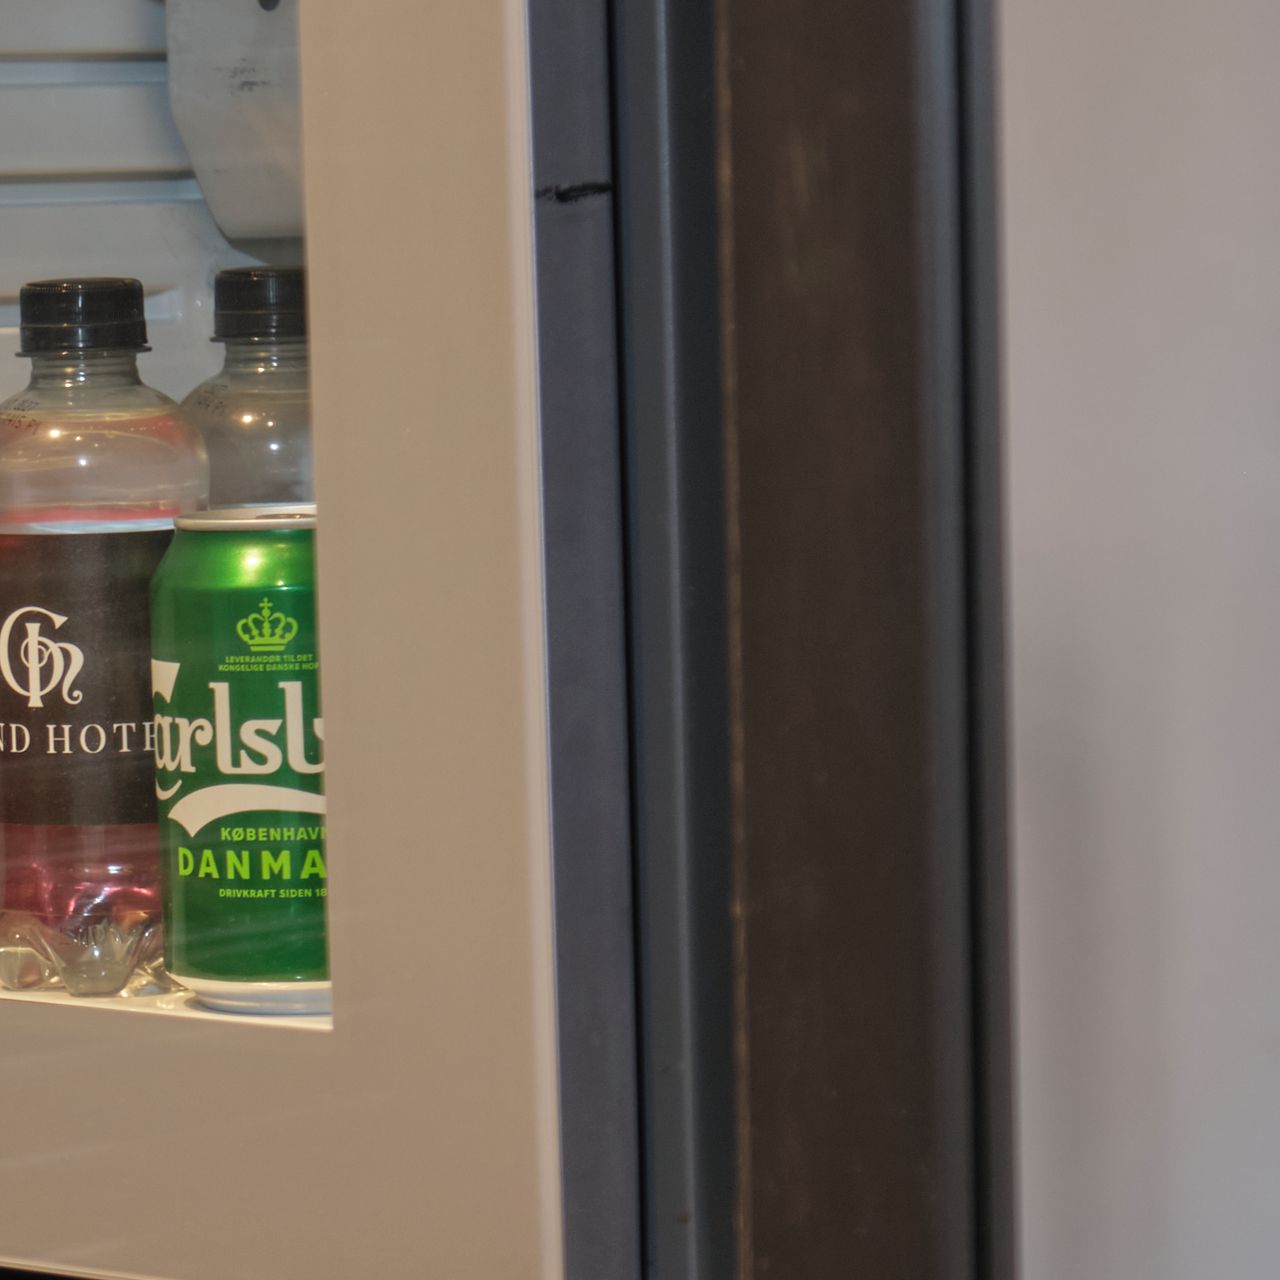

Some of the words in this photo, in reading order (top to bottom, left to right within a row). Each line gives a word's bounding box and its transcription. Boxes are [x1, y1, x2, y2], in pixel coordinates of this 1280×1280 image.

[218, 663, 264, 671] KONGELIGE
[266, 662, 300, 671] DANSKE
[178, 847, 328, 880] DANMA
[219, 888, 276, 898] DRIVKRAFT
[279, 888, 312, 898] SIDEN
